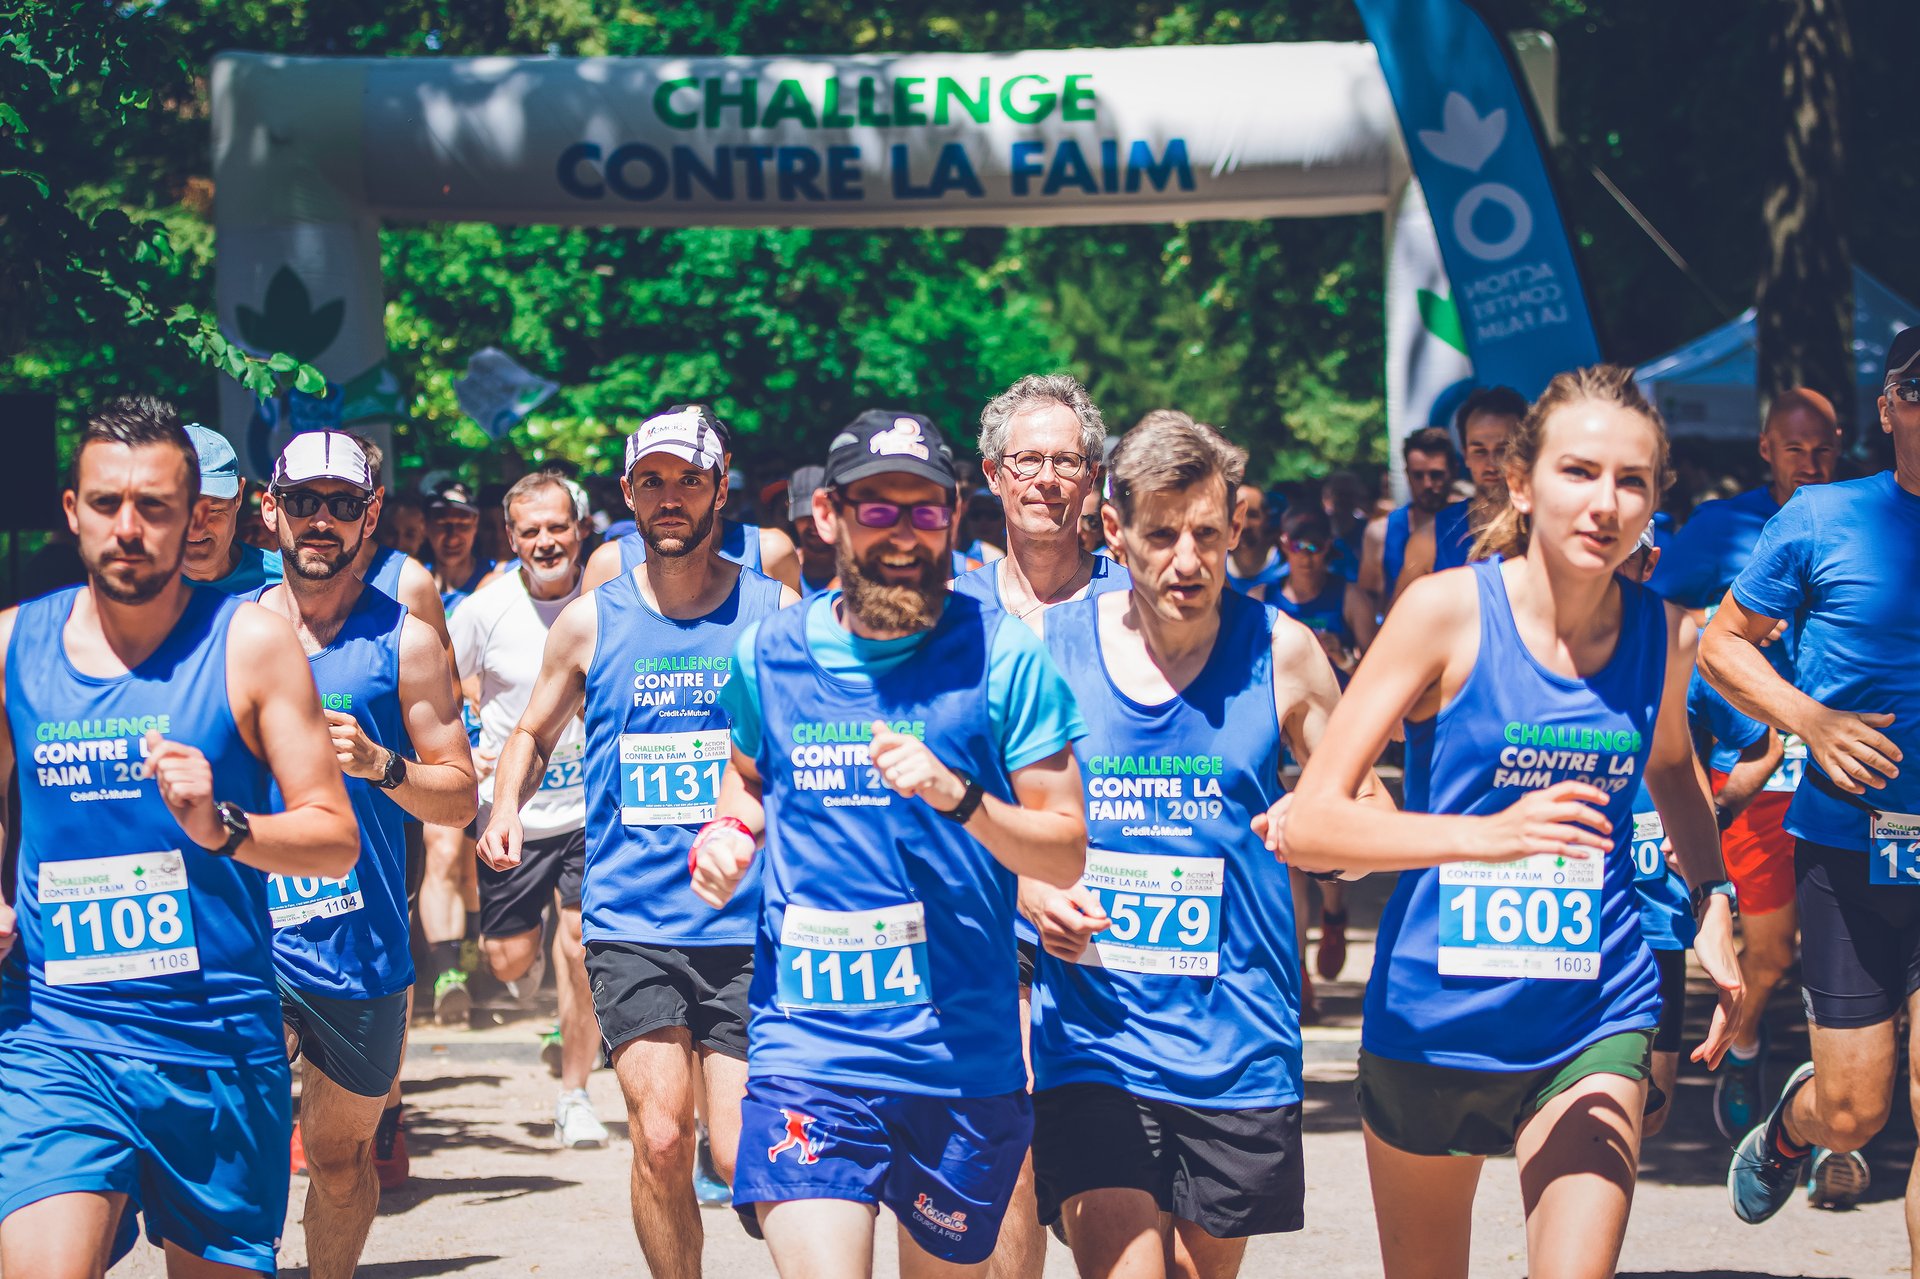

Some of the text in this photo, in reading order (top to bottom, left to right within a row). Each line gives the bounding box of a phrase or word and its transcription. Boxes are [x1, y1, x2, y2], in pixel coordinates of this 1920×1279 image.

[653, 74, 1097, 129] CHALLENGE
[556, 138, 1196, 201] CONTRE LA FAIM
[633, 673, 703, 689] CONTRE
[633, 690, 720, 706] FAIM 20
[687, 709, 710, 717] Mutuel
[36, 714, 170, 741] CHALLENGE
[791, 719, 926, 744] CHALLEGE
[33, 739, 128, 764] CONTRE
[625, 752, 652, 760] CONTRE
[654, 752, 664, 760] LA
[632, 744, 676, 752] CHALLENGE
[790, 744, 872, 767] CONTR
[1088, 755, 1223, 775] CHALLENGE
[1499, 746, 1635, 776] CONTRE LA
[37, 765, 92, 787] FAIM
[546, 761, 584, 788] 32
[629, 762, 721, 802] 1131
[792, 769, 847, 791] FAIM
[1492, 768, 1553, 788] FAIM
[1088, 777, 1223, 798] CONTRE LA
[700, 807, 713, 819] 11
[1089, 800, 1224, 821] FAIM 2019
[1876, 828, 1911, 836] CONTRE
[1082, 872, 1161, 889] ONTRE LA FAIM
[1089, 864, 1148, 879] CHALLENGE
[1447, 870, 1543, 881] CONTRE LA FAIM
[325, 895, 357, 914] 1104
[51, 894, 183, 953] 1108
[1450, 887, 1593, 945] 1603
[150, 953, 189, 970] 1108
[1169, 956, 1208, 970] 1579
[1554, 957, 1592, 973] 1603
[791, 946, 921, 1001] 1114
[912, 1211, 937, 1232] COURSE
[945, 1230, 962, 1242] PIED
